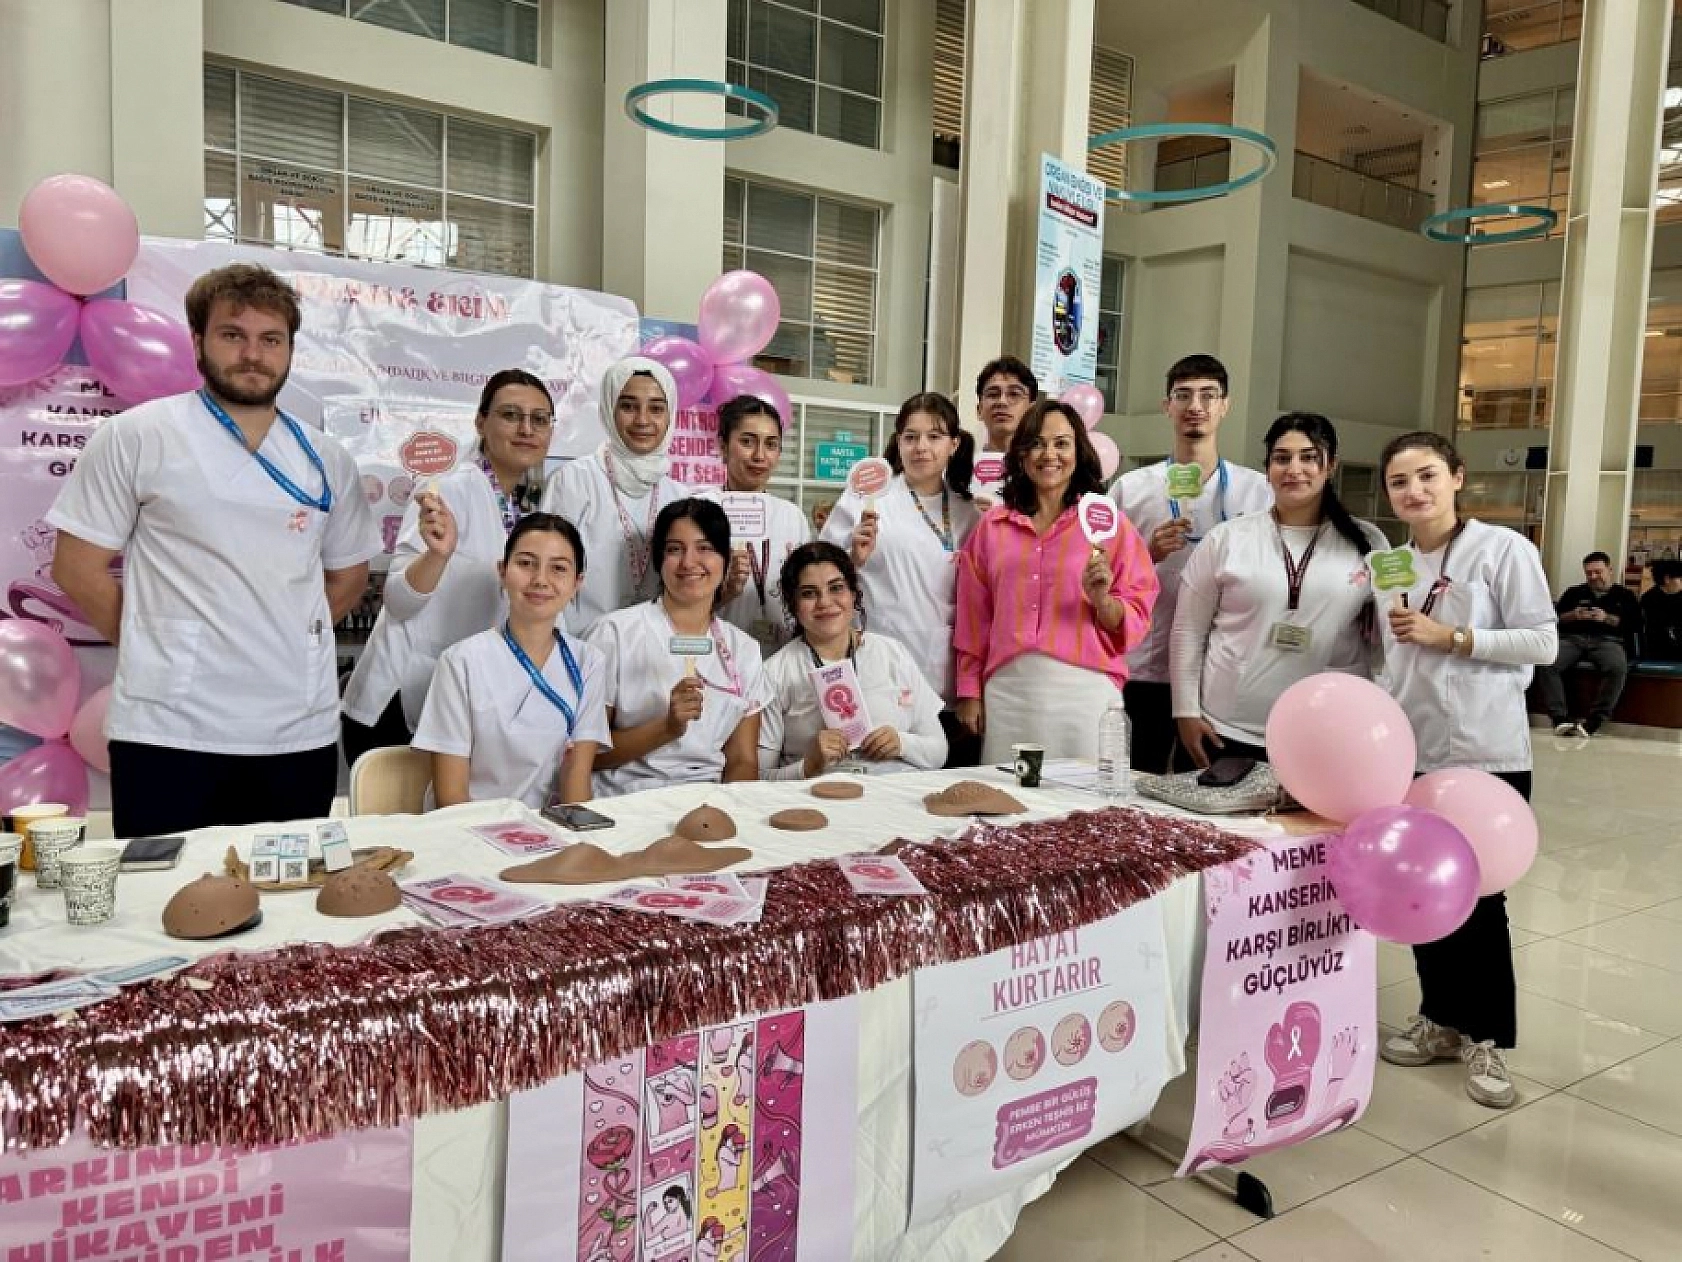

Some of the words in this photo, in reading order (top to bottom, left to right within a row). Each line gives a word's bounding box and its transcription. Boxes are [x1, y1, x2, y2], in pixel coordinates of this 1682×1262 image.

[1271, 843, 1326, 873] MEME
[1011, 929, 1080, 970] HAYAT
[1226, 928, 1283, 962] KARŞI
[992, 956, 1101, 1013] KURTARIR
[1243, 949, 1344, 996] GÜÇLÜYÜZ
[62, 1158, 238, 1229] KENDİ
[8, 1182, 284, 1262] HİKAYENİ
